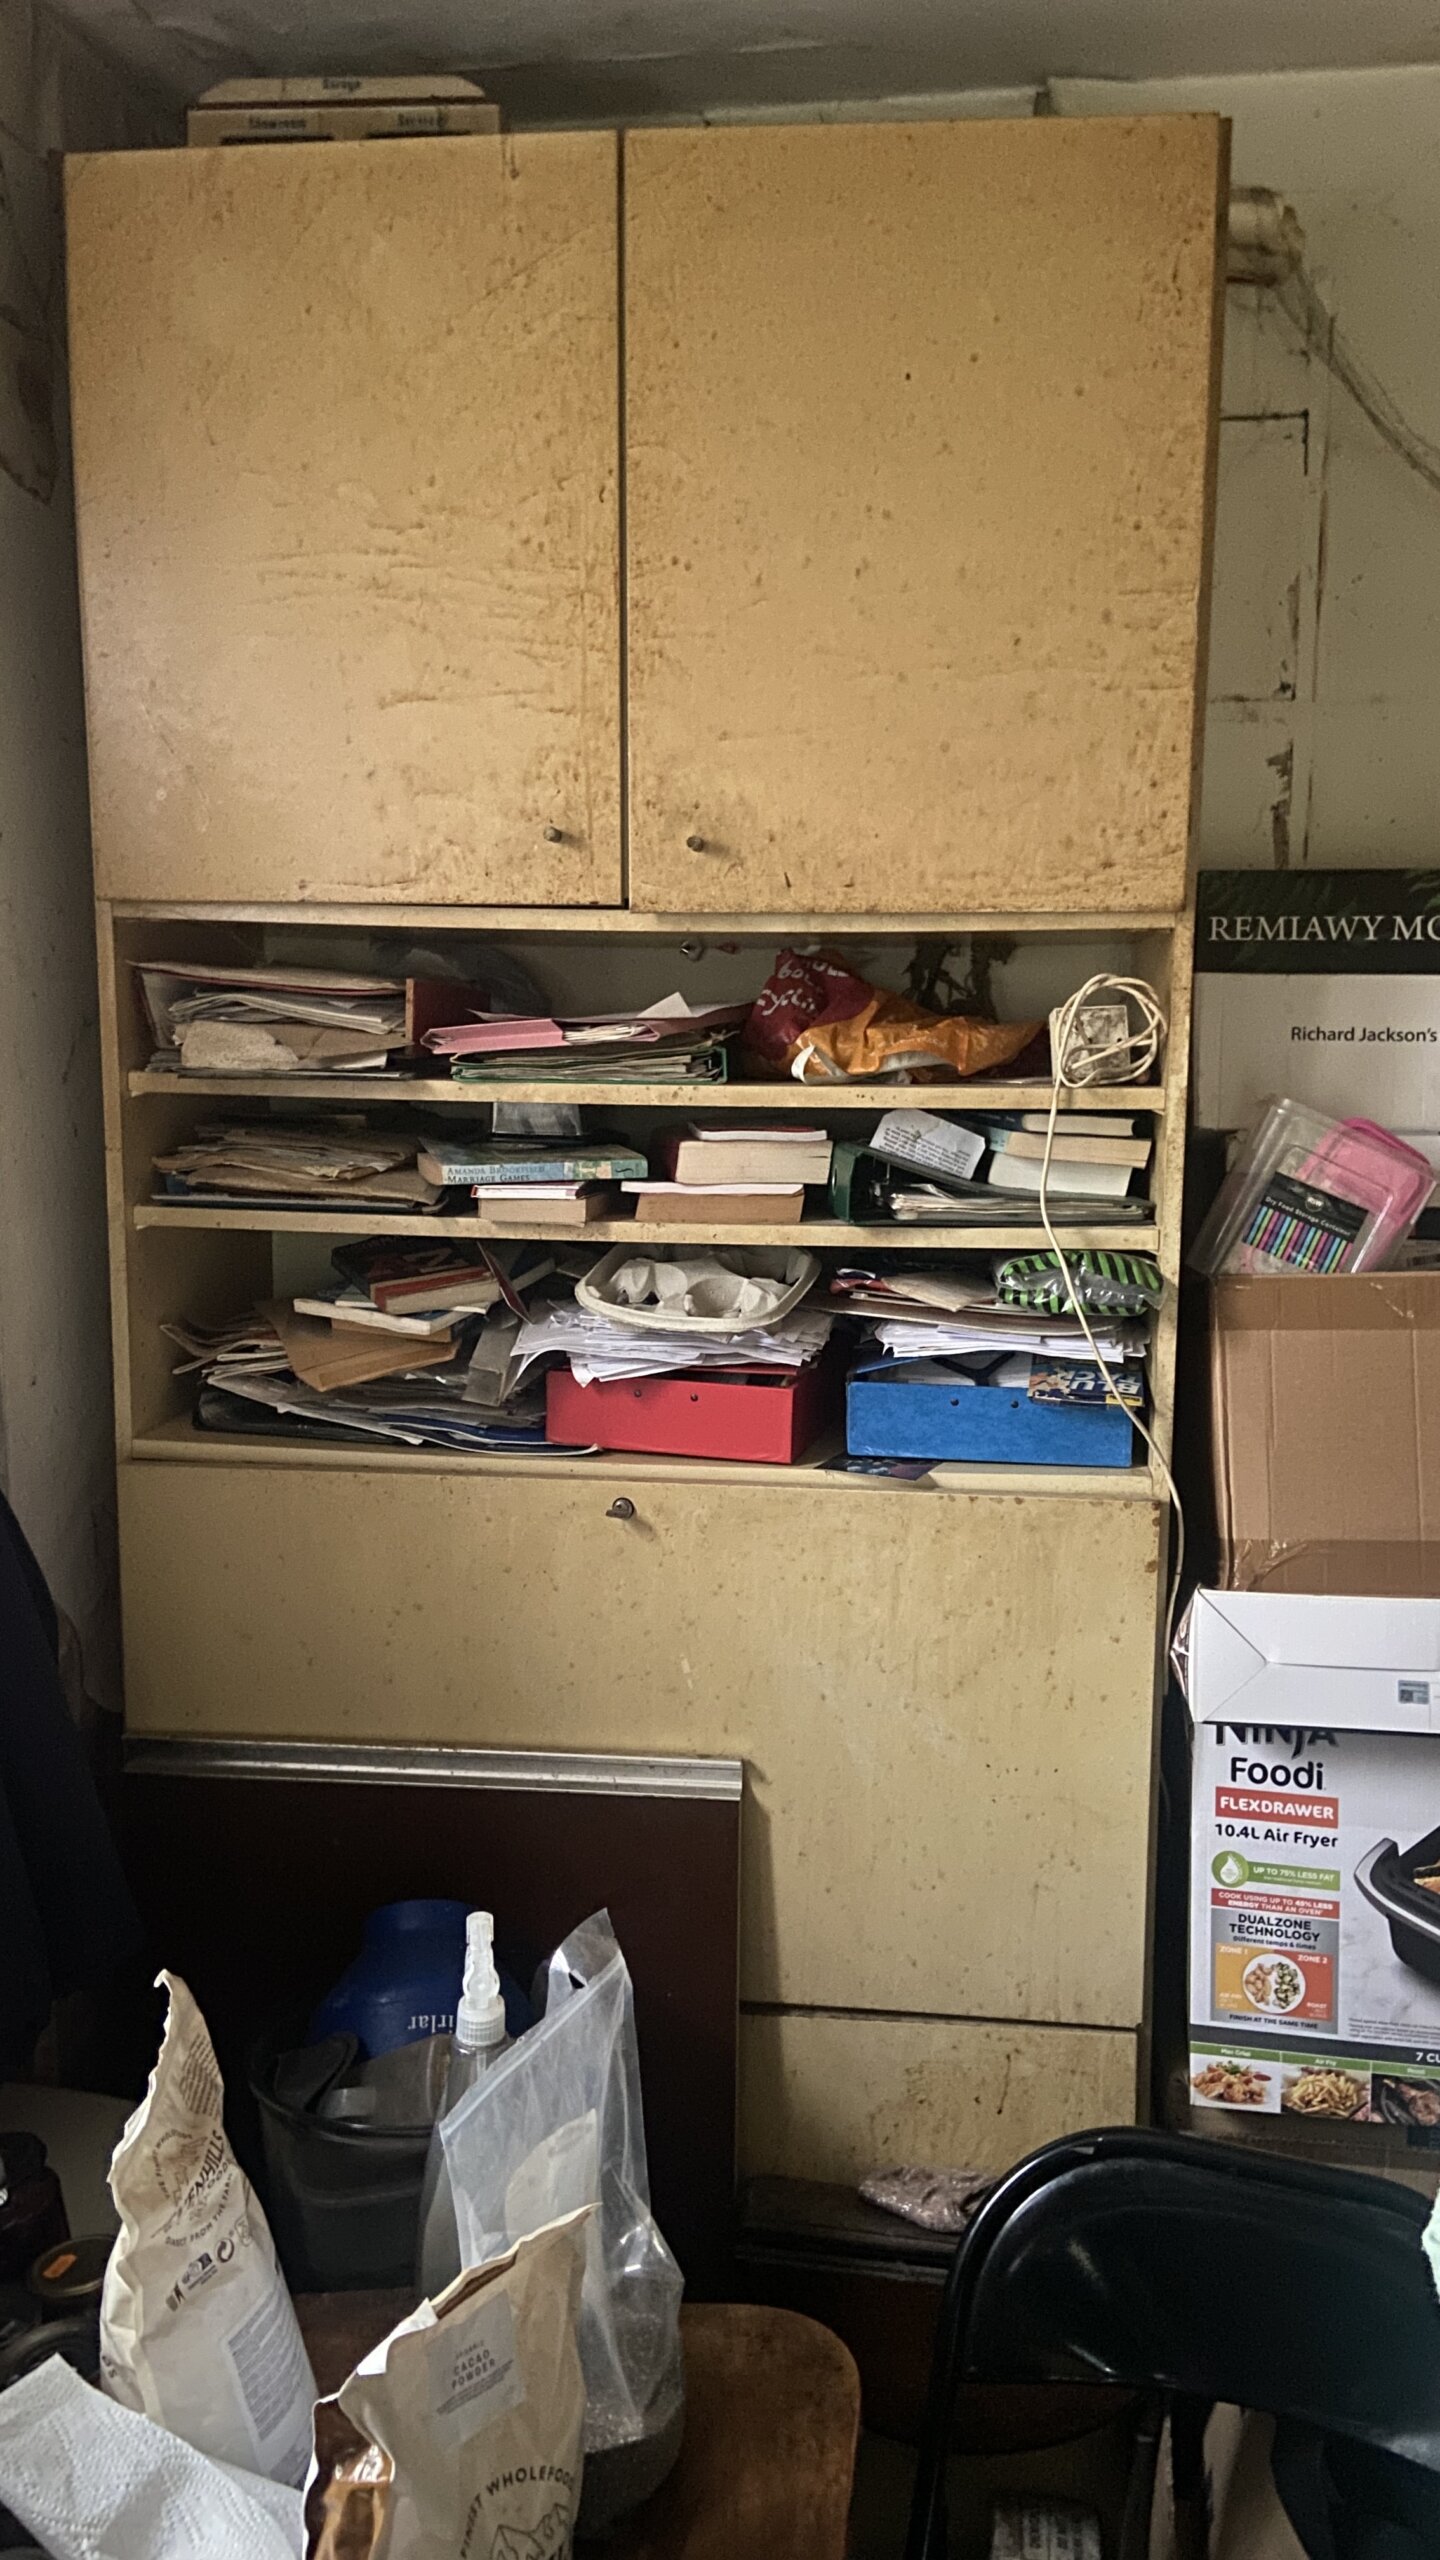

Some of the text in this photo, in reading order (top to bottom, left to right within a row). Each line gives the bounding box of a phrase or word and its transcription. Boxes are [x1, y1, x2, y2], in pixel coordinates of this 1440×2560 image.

[1209, 915, 1384, 942] REMIAWY
[1290, 1025, 1438, 1043] Richard Jackson's
[447, 1164, 487, 1176] AMANDA
[447, 1174, 531, 1184] MARRIAGE GAMES
[1265, 1195, 1277, 1206] Dry
[1277, 1200, 1295, 1213] Food
[1294, 1206, 1320, 1224] Storage
[1069, 1380, 1140, 1395] BLU
[1230, 1756, 1325, 1791] Foodi
[1219, 1795, 1335, 1821] FLEXDRAWER
[1214, 1823, 1339, 1849] 10.4L Air Fryer
[1252, 1866, 1265, 1874] UP
[1266, 1868, 1279, 1876] TO
[1279, 1869, 1296, 1878] 75%
[1296, 1870, 1318, 1881] LESS
[1318, 1873, 1336, 1882] FAT
[1218, 1891, 1242, 1900] COOK
[1243, 1893, 1268, 1903] USING
[1269, 1896, 1281, 1904] UP
[1282, 1897, 1294, 1906] TO
[1312, 1901, 1334, 1911] LESS
[1228, 1899, 1260, 1910] ENERGY
[1261, 1902, 1284, 1912] THAN
[1284, 1904, 1297, 1914] AN
[1237, 1913, 1312, 1931] DUALZONE
[1228, 1923, 1321, 1943] TECHNOLOGY
[1232, 1935, 1265, 1945] Different
[1265, 1938, 1288, 1949] temps
[1219, 1945, 1243, 1955] ZONE
[1296, 1954, 1321, 1963] ZONE
[1229, 2013, 1319, 2030] FINISH AT THE SAME TIME
[1415, 2051, 1424, 2062] 7
[189, 2221, 213, 2242] FROM
[213, 2203, 226, 2222] THE
[453, 2348, 490, 2377] CACAO
[451, 2358, 496, 2391] POWDER
